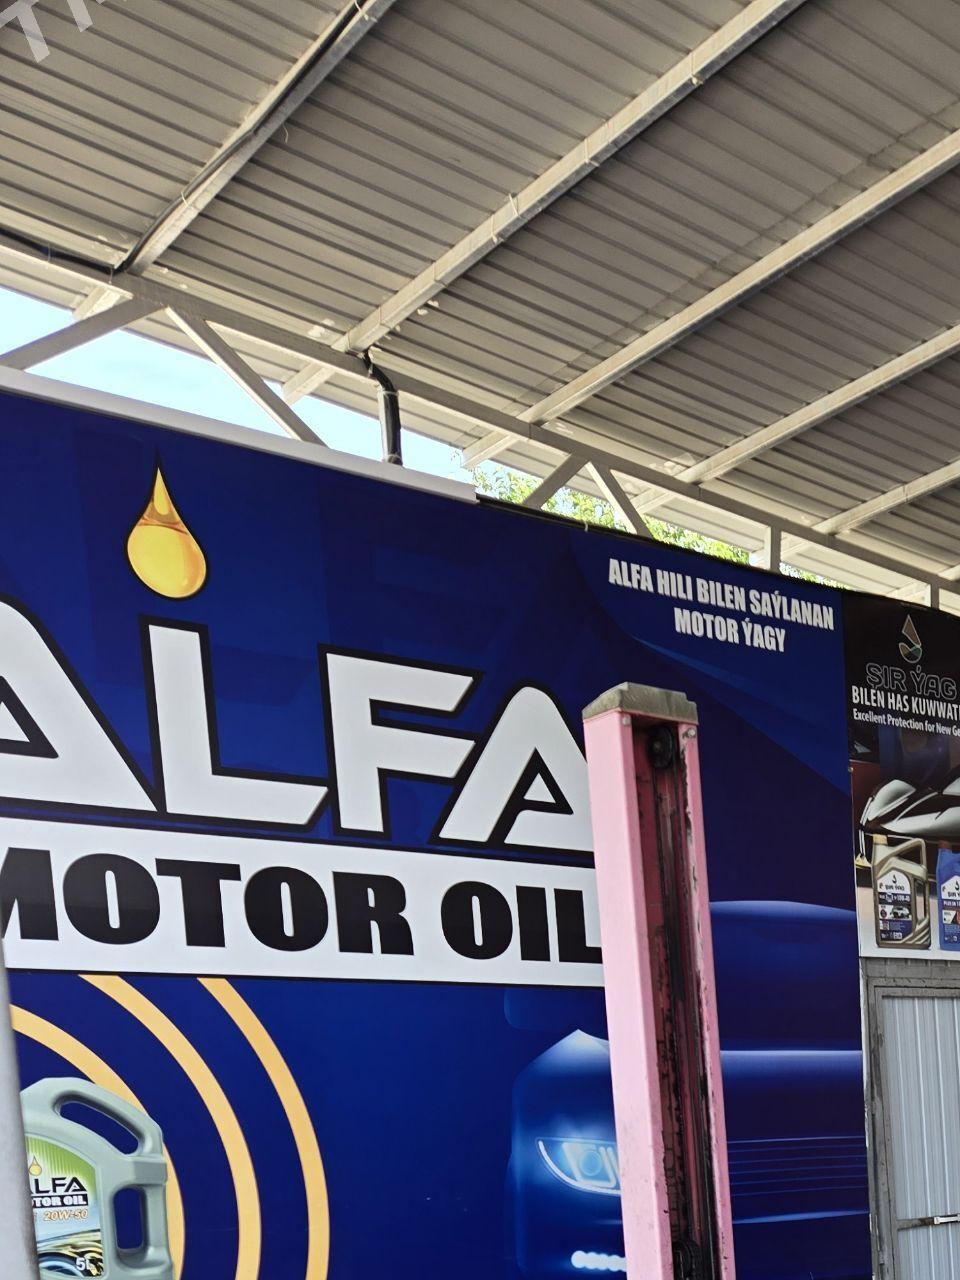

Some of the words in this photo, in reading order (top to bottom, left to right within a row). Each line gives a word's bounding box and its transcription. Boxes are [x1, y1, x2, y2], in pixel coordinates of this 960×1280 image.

[609, 558, 653, 592] ALFA
[656, 569, 693, 601] HILI
[696, 577, 747, 612] BILEN
[750, 590, 834, 630] SAÝLANAN
[674, 607, 739, 644] MOTOR
[742, 617, 786, 652] ÝAGY
[851, 685, 885, 709] BILEN
[887, 691, 909, 713] HAS
[853, 708, 886, 725] Excellent
[887, 713, 924, 731] Protection
[925, 720, 935, 733] for
[936, 722, 951, 736] New
[441, 880, 603, 964] OIL
[31, 1176, 88, 1194] LFA
[32, 1196, 61, 1207] TOR
[63, 1195, 87, 1206] OIL
[43, 1209, 88, 1221] 20W-50
